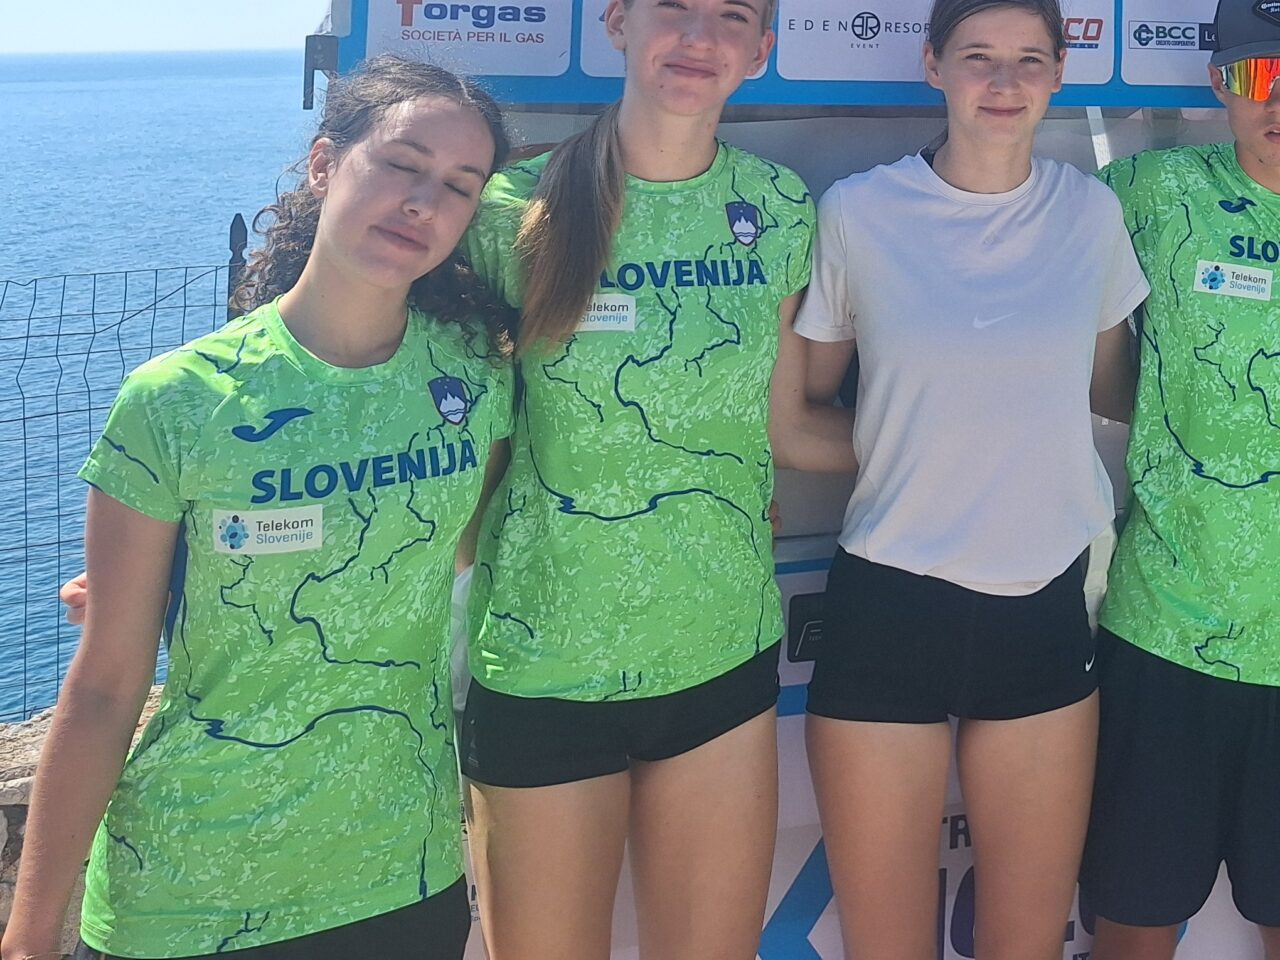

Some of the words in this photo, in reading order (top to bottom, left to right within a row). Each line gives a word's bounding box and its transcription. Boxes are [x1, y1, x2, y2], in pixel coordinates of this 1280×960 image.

[788, 18, 848, 32] EDEN
[401, 28, 462, 42] SOCIETÀ
[466, 31, 496, 42] PER
[499, 32, 510, 43] IL
[516, 32, 545, 44] GAS
[1155, 26, 1196, 40] BCC
[600, 259, 767, 291] LOVENIJA
[1231, 272, 1267, 285] Telekom
[1229, 281, 1266, 294] Slovenije
[250, 440, 478, 504] SLOVENIJA
[256, 517, 314, 532] Telekom
[256, 530, 314, 545] Slovenije
